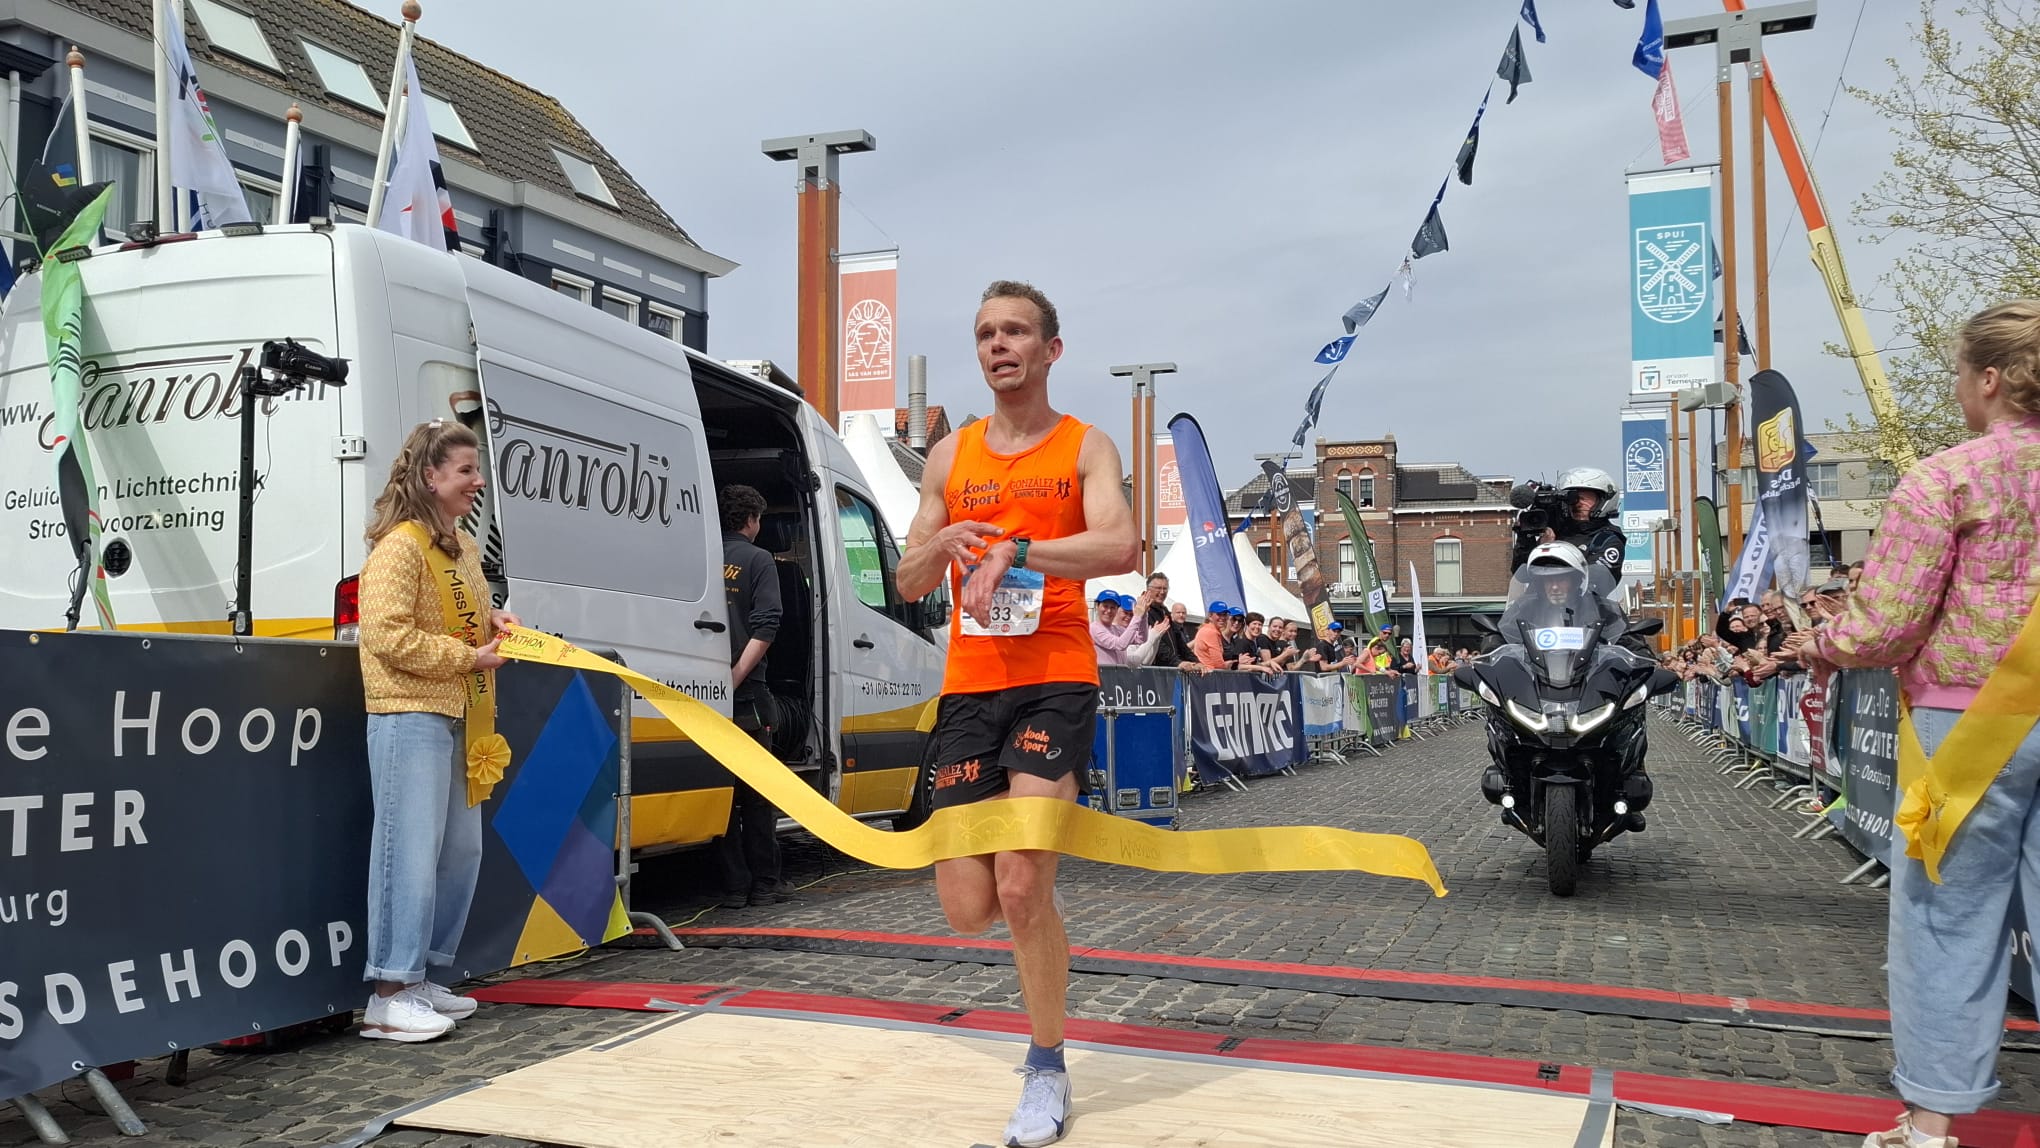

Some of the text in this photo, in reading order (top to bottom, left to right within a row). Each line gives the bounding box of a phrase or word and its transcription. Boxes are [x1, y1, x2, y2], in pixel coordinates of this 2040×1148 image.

[1656, 231, 1685, 240] SPUI
[116, 469, 266, 499] Lichttechnik
[963, 478, 1001, 496] koole
[1014, 490, 1048, 499] RUNNING TEAM
[962, 493, 1001, 511] Sport
[29, 506, 225, 540] Strovoorziening
[458, 611, 489, 694] MARON
[861, 682, 922, 700] +31 (0)6 531 22 703
[1098, 685, 1161, 707] s-De Ho
[112, 690, 322, 767] Hoop
[1024, 724, 1050, 743] koole
[1022, 740, 1049, 754] Sport
[1861, 764, 1892, 791] Oostburg
[0, 789, 149, 857] TER
[0, 920, 354, 1041] SDEHOOP
